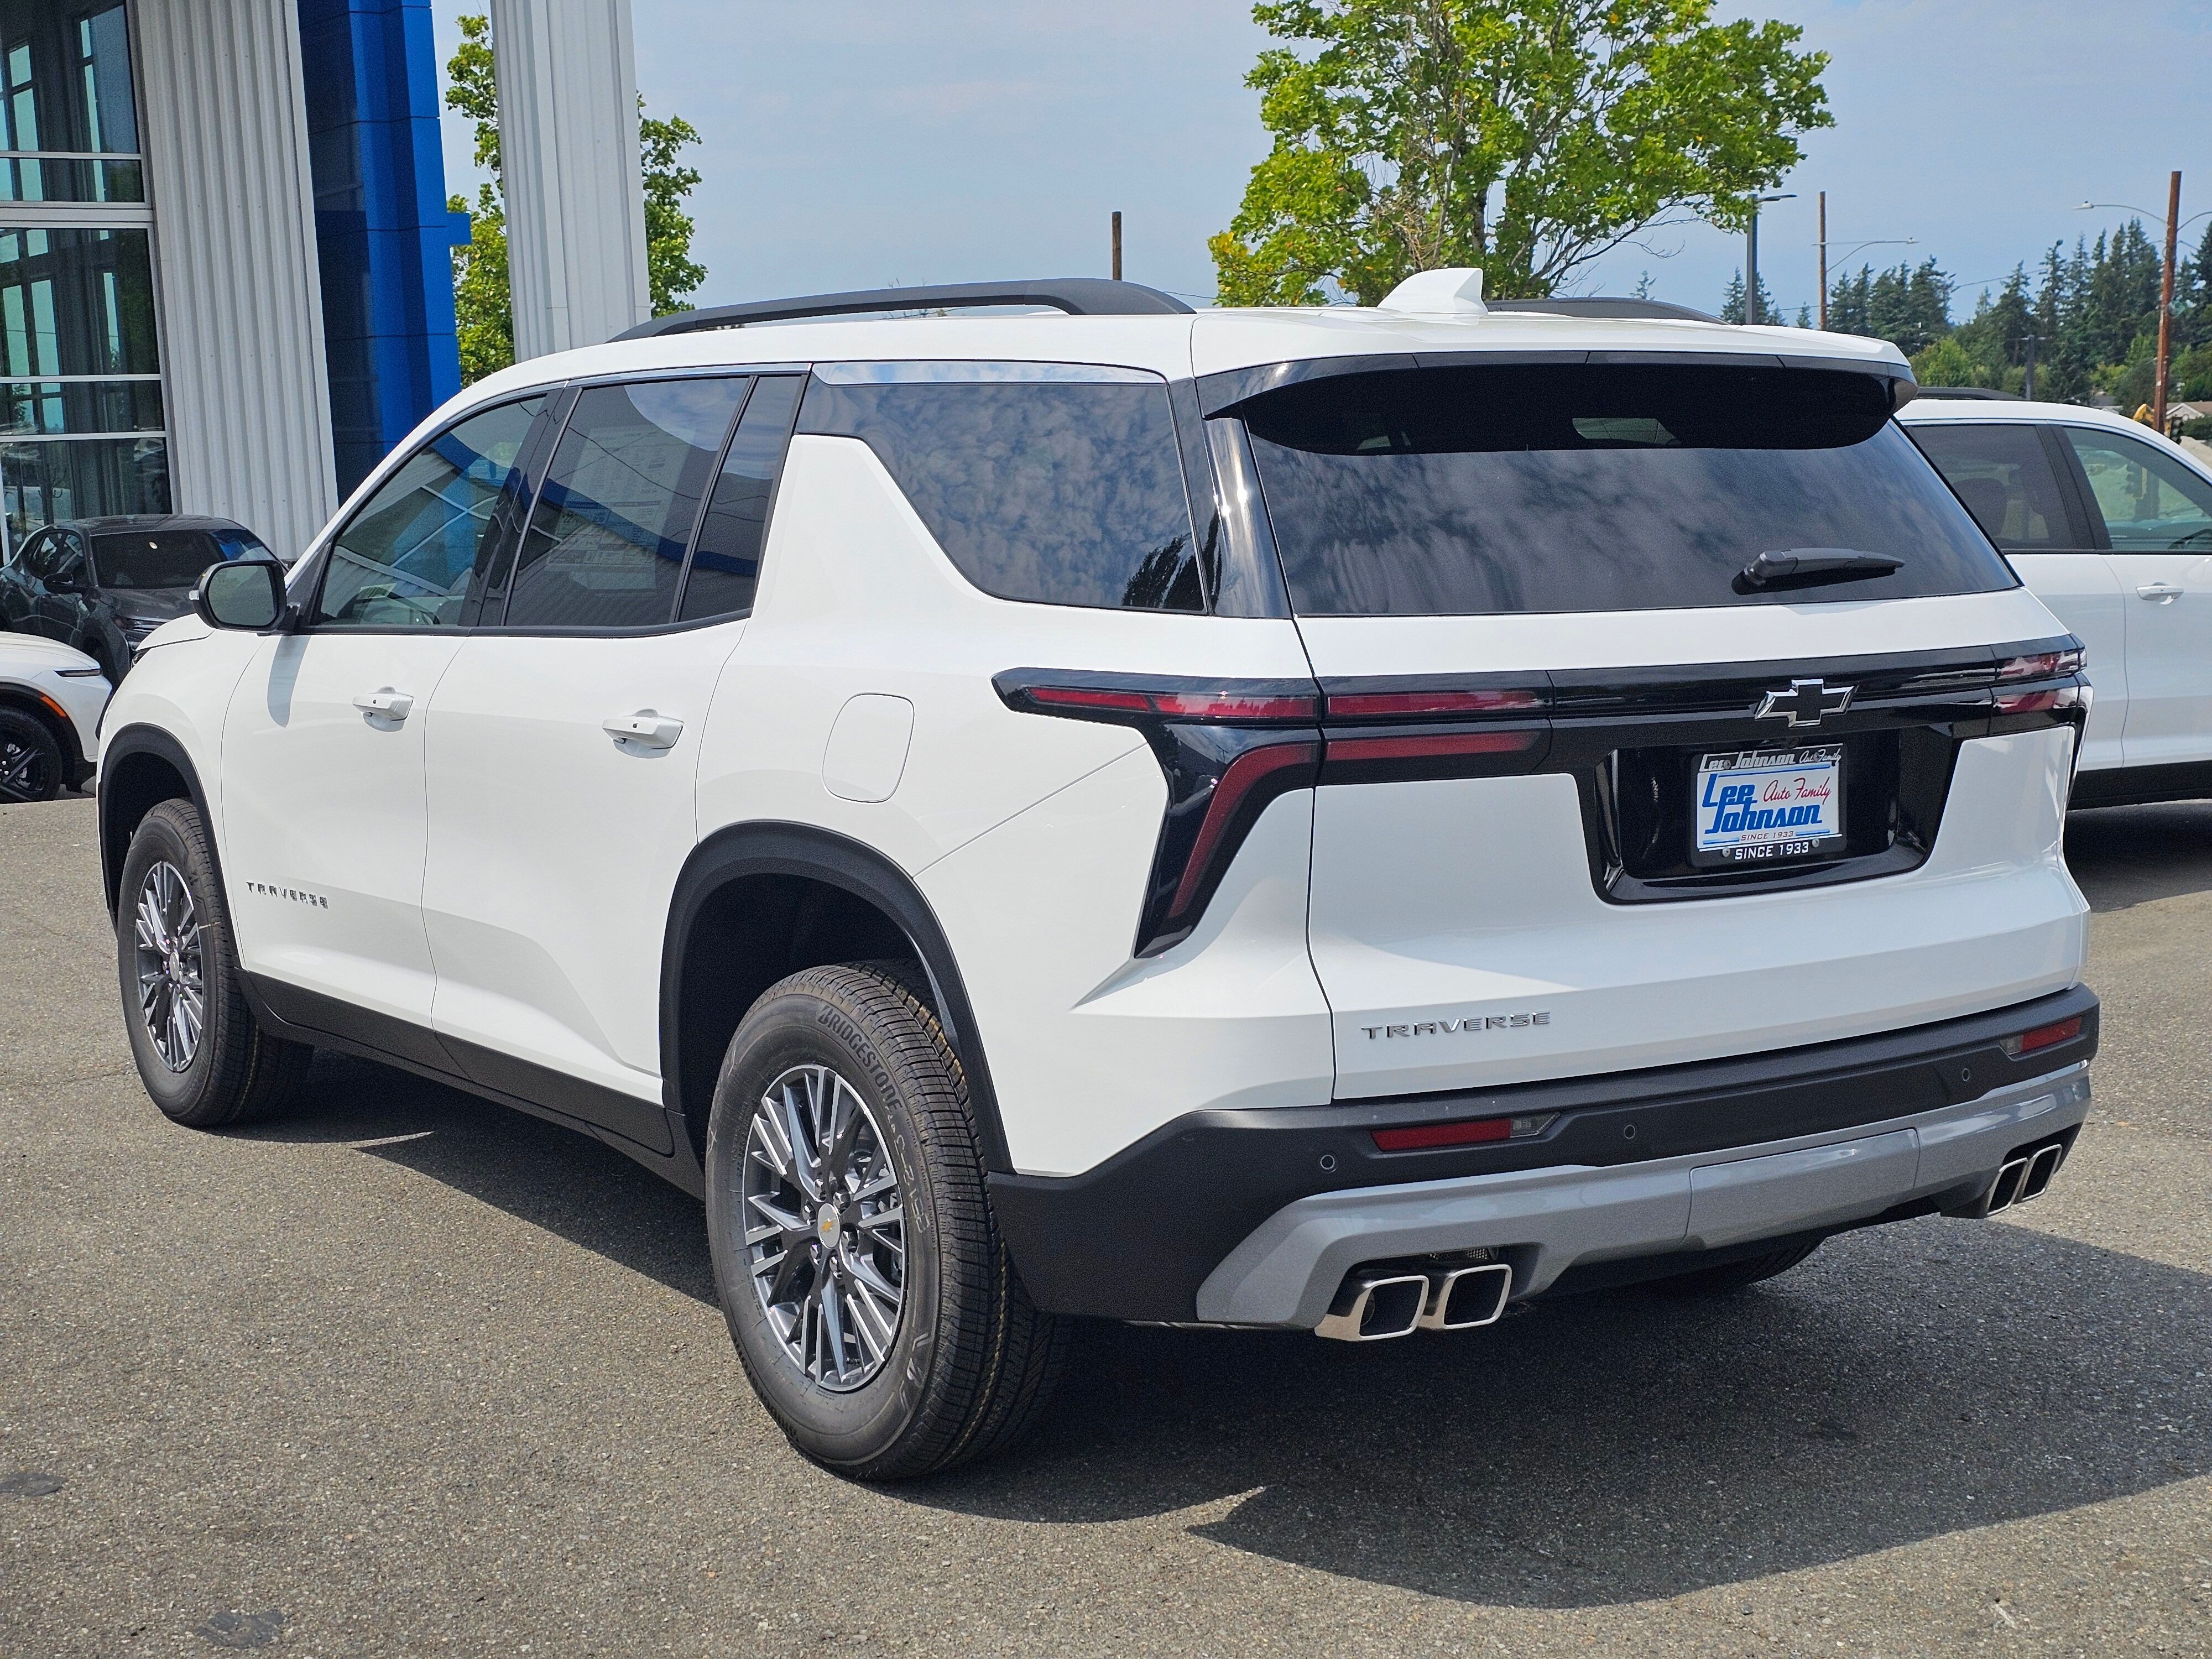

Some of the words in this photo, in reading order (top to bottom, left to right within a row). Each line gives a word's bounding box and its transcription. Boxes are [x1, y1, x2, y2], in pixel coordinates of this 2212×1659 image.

[1731, 750, 1796, 769] Johnson
[1799, 750, 1819, 763] Aut
[1818, 748, 1841, 765] Family
[1702, 773, 1757, 807] Lee
[1763, 780, 1792, 802] Auto
[1793, 776, 1832, 805] Family
[1704, 798, 1823, 834] Johnson
[1735, 846, 1773, 859] SINCE
[1780, 842, 1809, 855] 1933
[1741, 832, 1768, 841] SINCE
[246, 881, 328, 909] TRAVERSE
[1361, 1010, 1550, 1040] TRAVERSE
[817, 1005, 902, 1111] BRIDGESTONE
